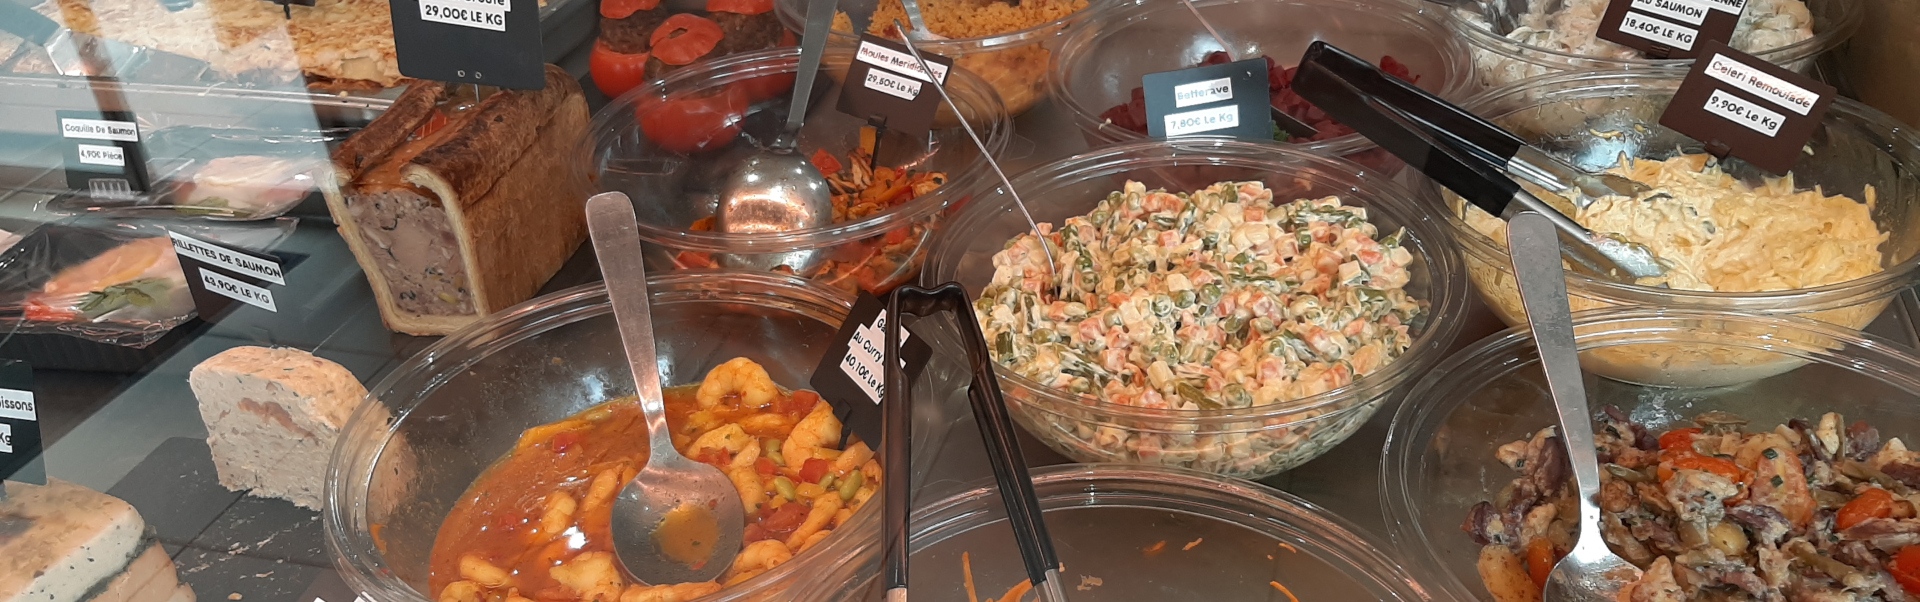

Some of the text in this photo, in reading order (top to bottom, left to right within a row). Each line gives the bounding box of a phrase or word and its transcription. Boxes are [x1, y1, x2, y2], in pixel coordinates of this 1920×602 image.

[425, 4, 503, 26] 29,00€ LE KG
[1655, 0, 1703, 19] SAUMON
[1624, 17, 1693, 44] 18,40€ LE KG
[860, 46, 889, 63] Moules
[867, 73, 896, 90] 29,50€
[907, 85, 919, 97] Kg
[1747, 76, 1811, 109] Remoulade
[1218, 112, 1234, 123] Kg
[1710, 95, 1778, 131] 9,90€ Le Kg
[107, 126, 136, 136] Saumon
[218, 252, 234, 265] DE
[234, 257, 283, 279] SAUMON
[204, 275, 270, 304] 43,90€ LE KG
[852, 331, 883, 363] Au Curry
[845, 353, 870, 380] 40,10€
[867, 374, 876, 388] Le
[0, 395, 33, 412] issons
